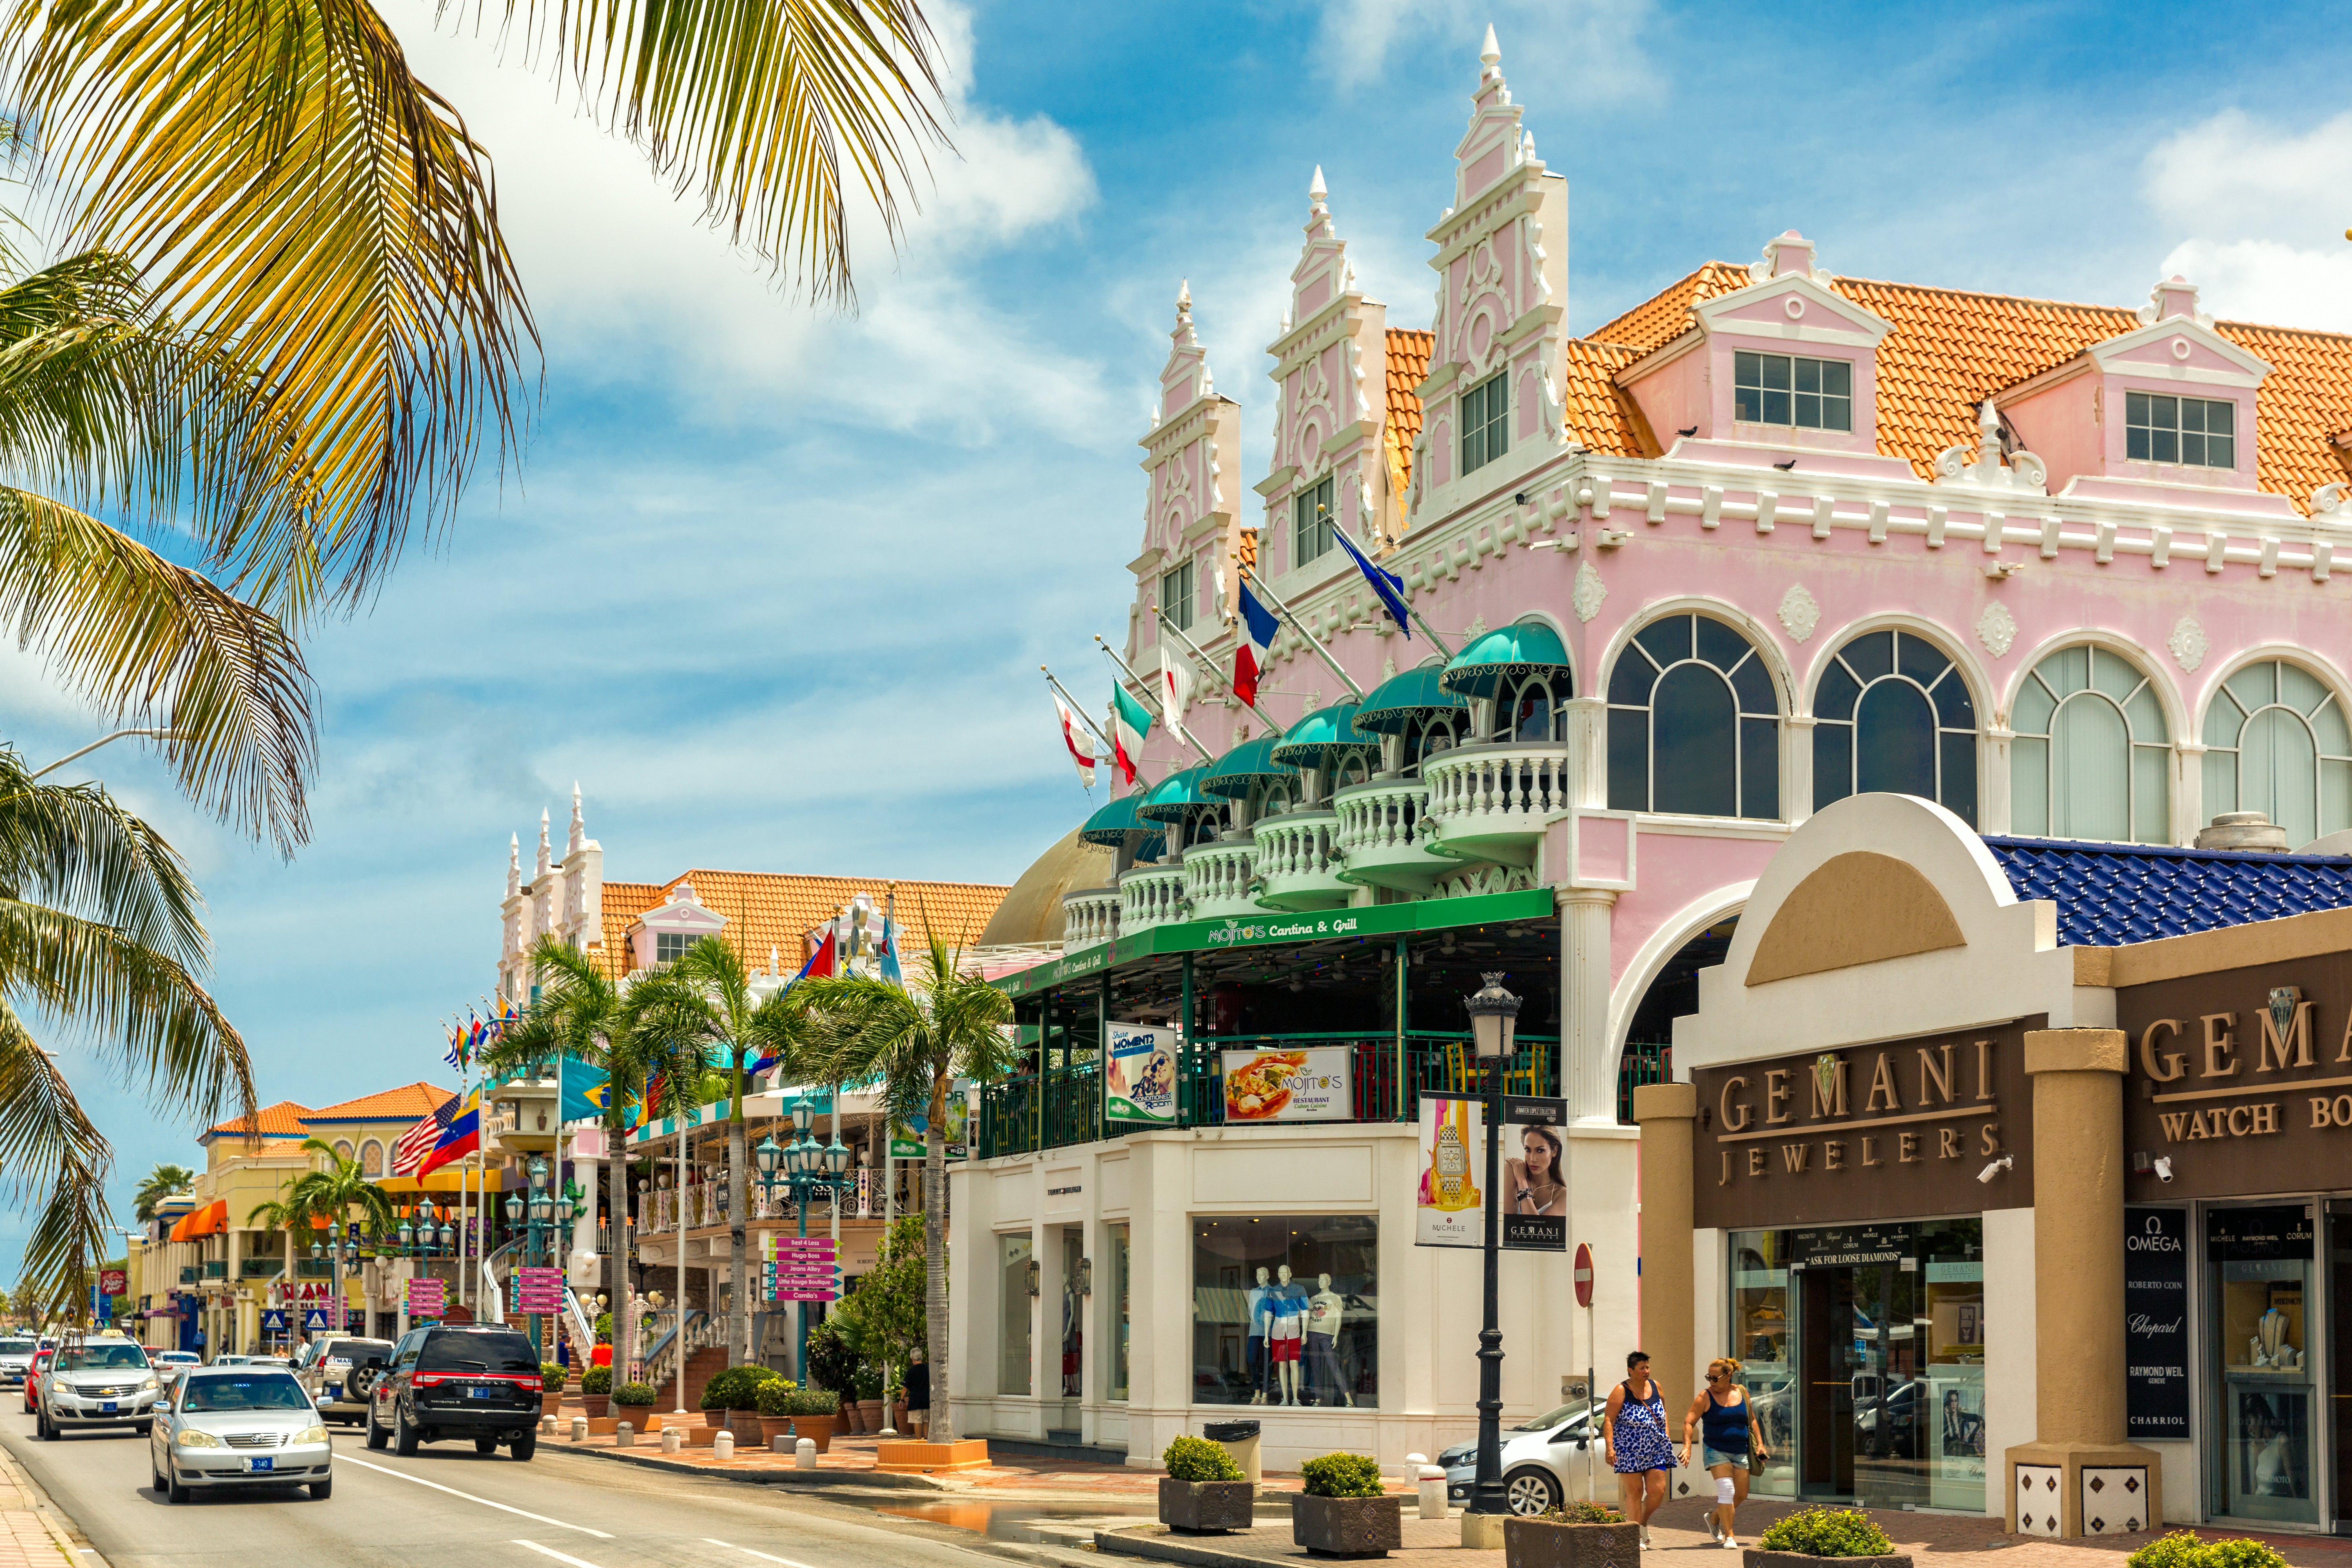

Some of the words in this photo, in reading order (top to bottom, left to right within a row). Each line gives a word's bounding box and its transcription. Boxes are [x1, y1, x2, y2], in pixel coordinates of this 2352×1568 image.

[1269, 923, 1313, 936] Cantina
[1317, 921, 1327, 932] &
[1333, 918, 1357, 933] Grill
[1072, 958, 1086, 973] Cantina
[1087, 958, 1091, 966] &
[1092, 954, 1101, 968] Grill
[1112, 1031, 1128, 1039] Share
[1114, 1033, 1154, 1050] MOMENTS
[1114, 1048, 1135, 1057] FREE
[1130, 1076, 1160, 1099] Air
[1281, 1075, 1342, 1096] MOJITO'S
[1720, 1040, 1994, 1131] GEMANI
[1134, 1094, 1171, 1102] CONDITIONED
[2159, 1103, 2280, 1142] WATCH
[2309, 1094, 2352, 1128] BO
[1719, 1123, 1998, 1186] JEWELERS
[1511, 1226, 1559, 1235] GEMANI
[2127, 1236, 2182, 1251] OMEGA
[1824, 1255, 1837, 1264] FOR
[1839, 1253, 1860, 1263] LOOSE
[2127, 1313, 2182, 1339] Chopard
[2129, 1366, 2164, 1376] RAYMOND
[2165, 1366, 2184, 1376] WEIL
[2130, 1417, 2185, 1425] CHARRIOL
